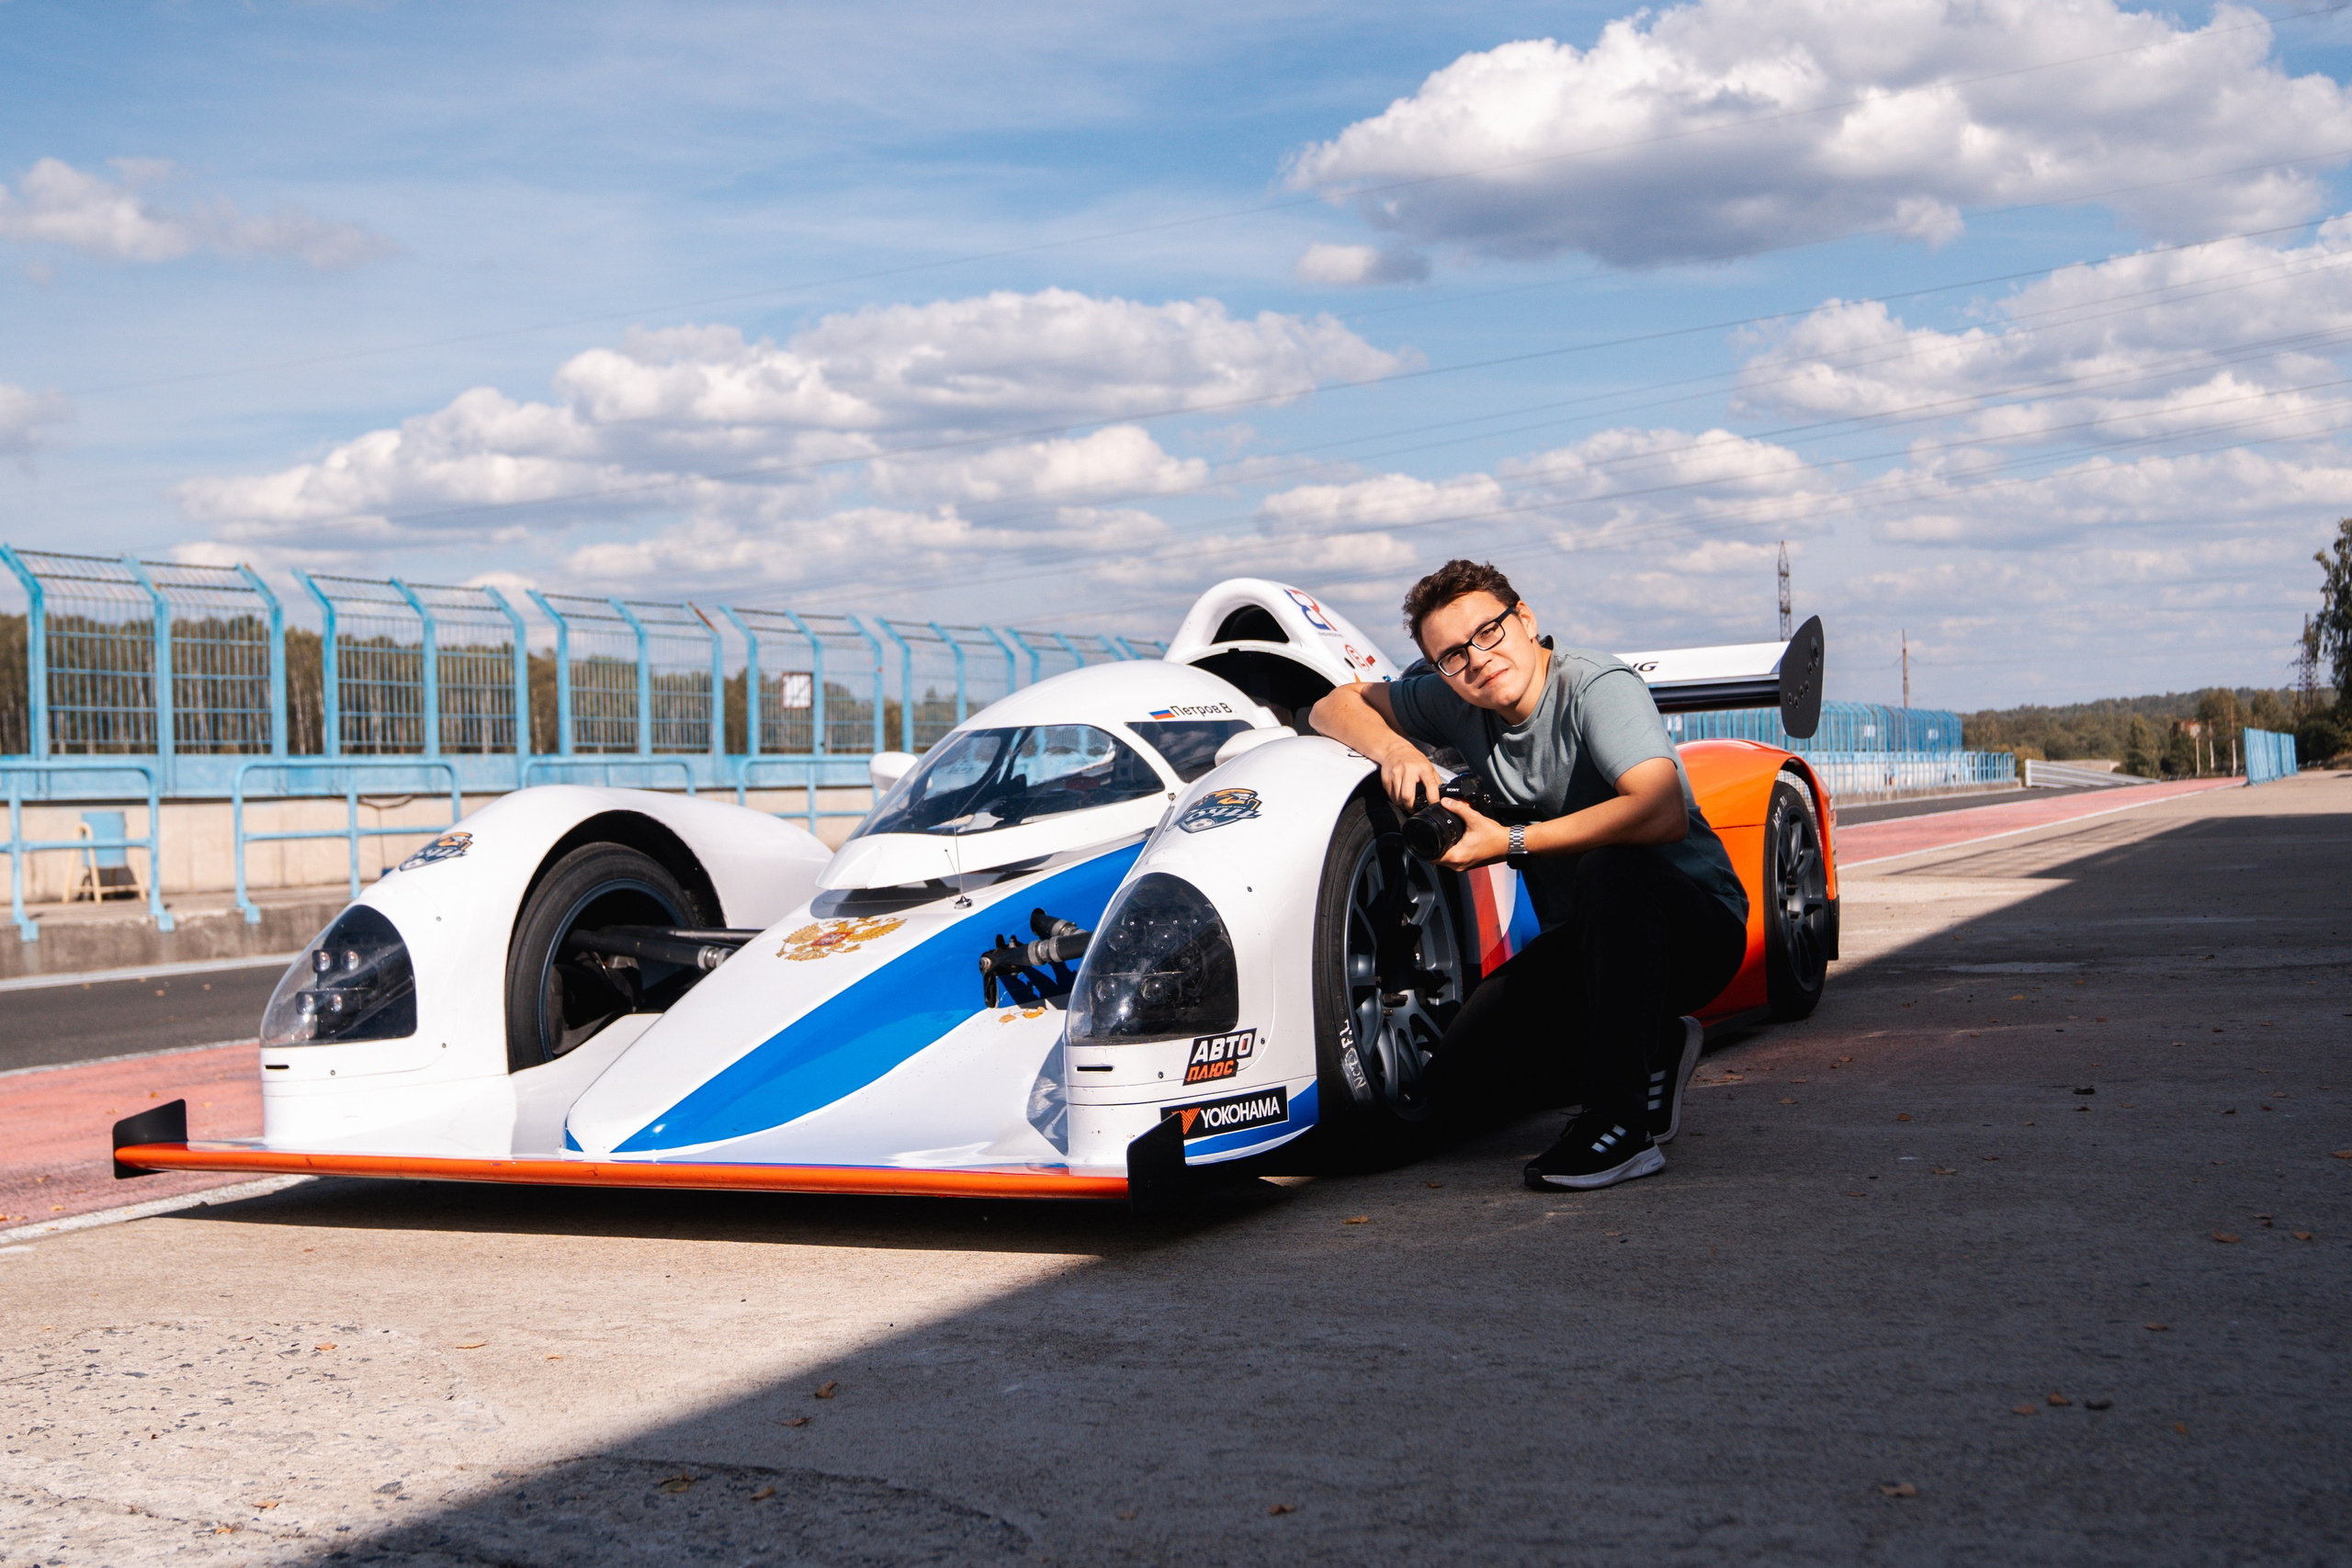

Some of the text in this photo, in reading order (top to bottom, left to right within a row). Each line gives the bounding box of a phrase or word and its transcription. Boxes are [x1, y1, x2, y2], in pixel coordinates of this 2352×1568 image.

[1170, 705, 1222, 717] Петров
[1191, 1032, 1253, 1065] АВТО
[1186, 1059, 1235, 1082] ПЛЮС
[1200, 1096, 1281, 1129] YOKOHAMA
